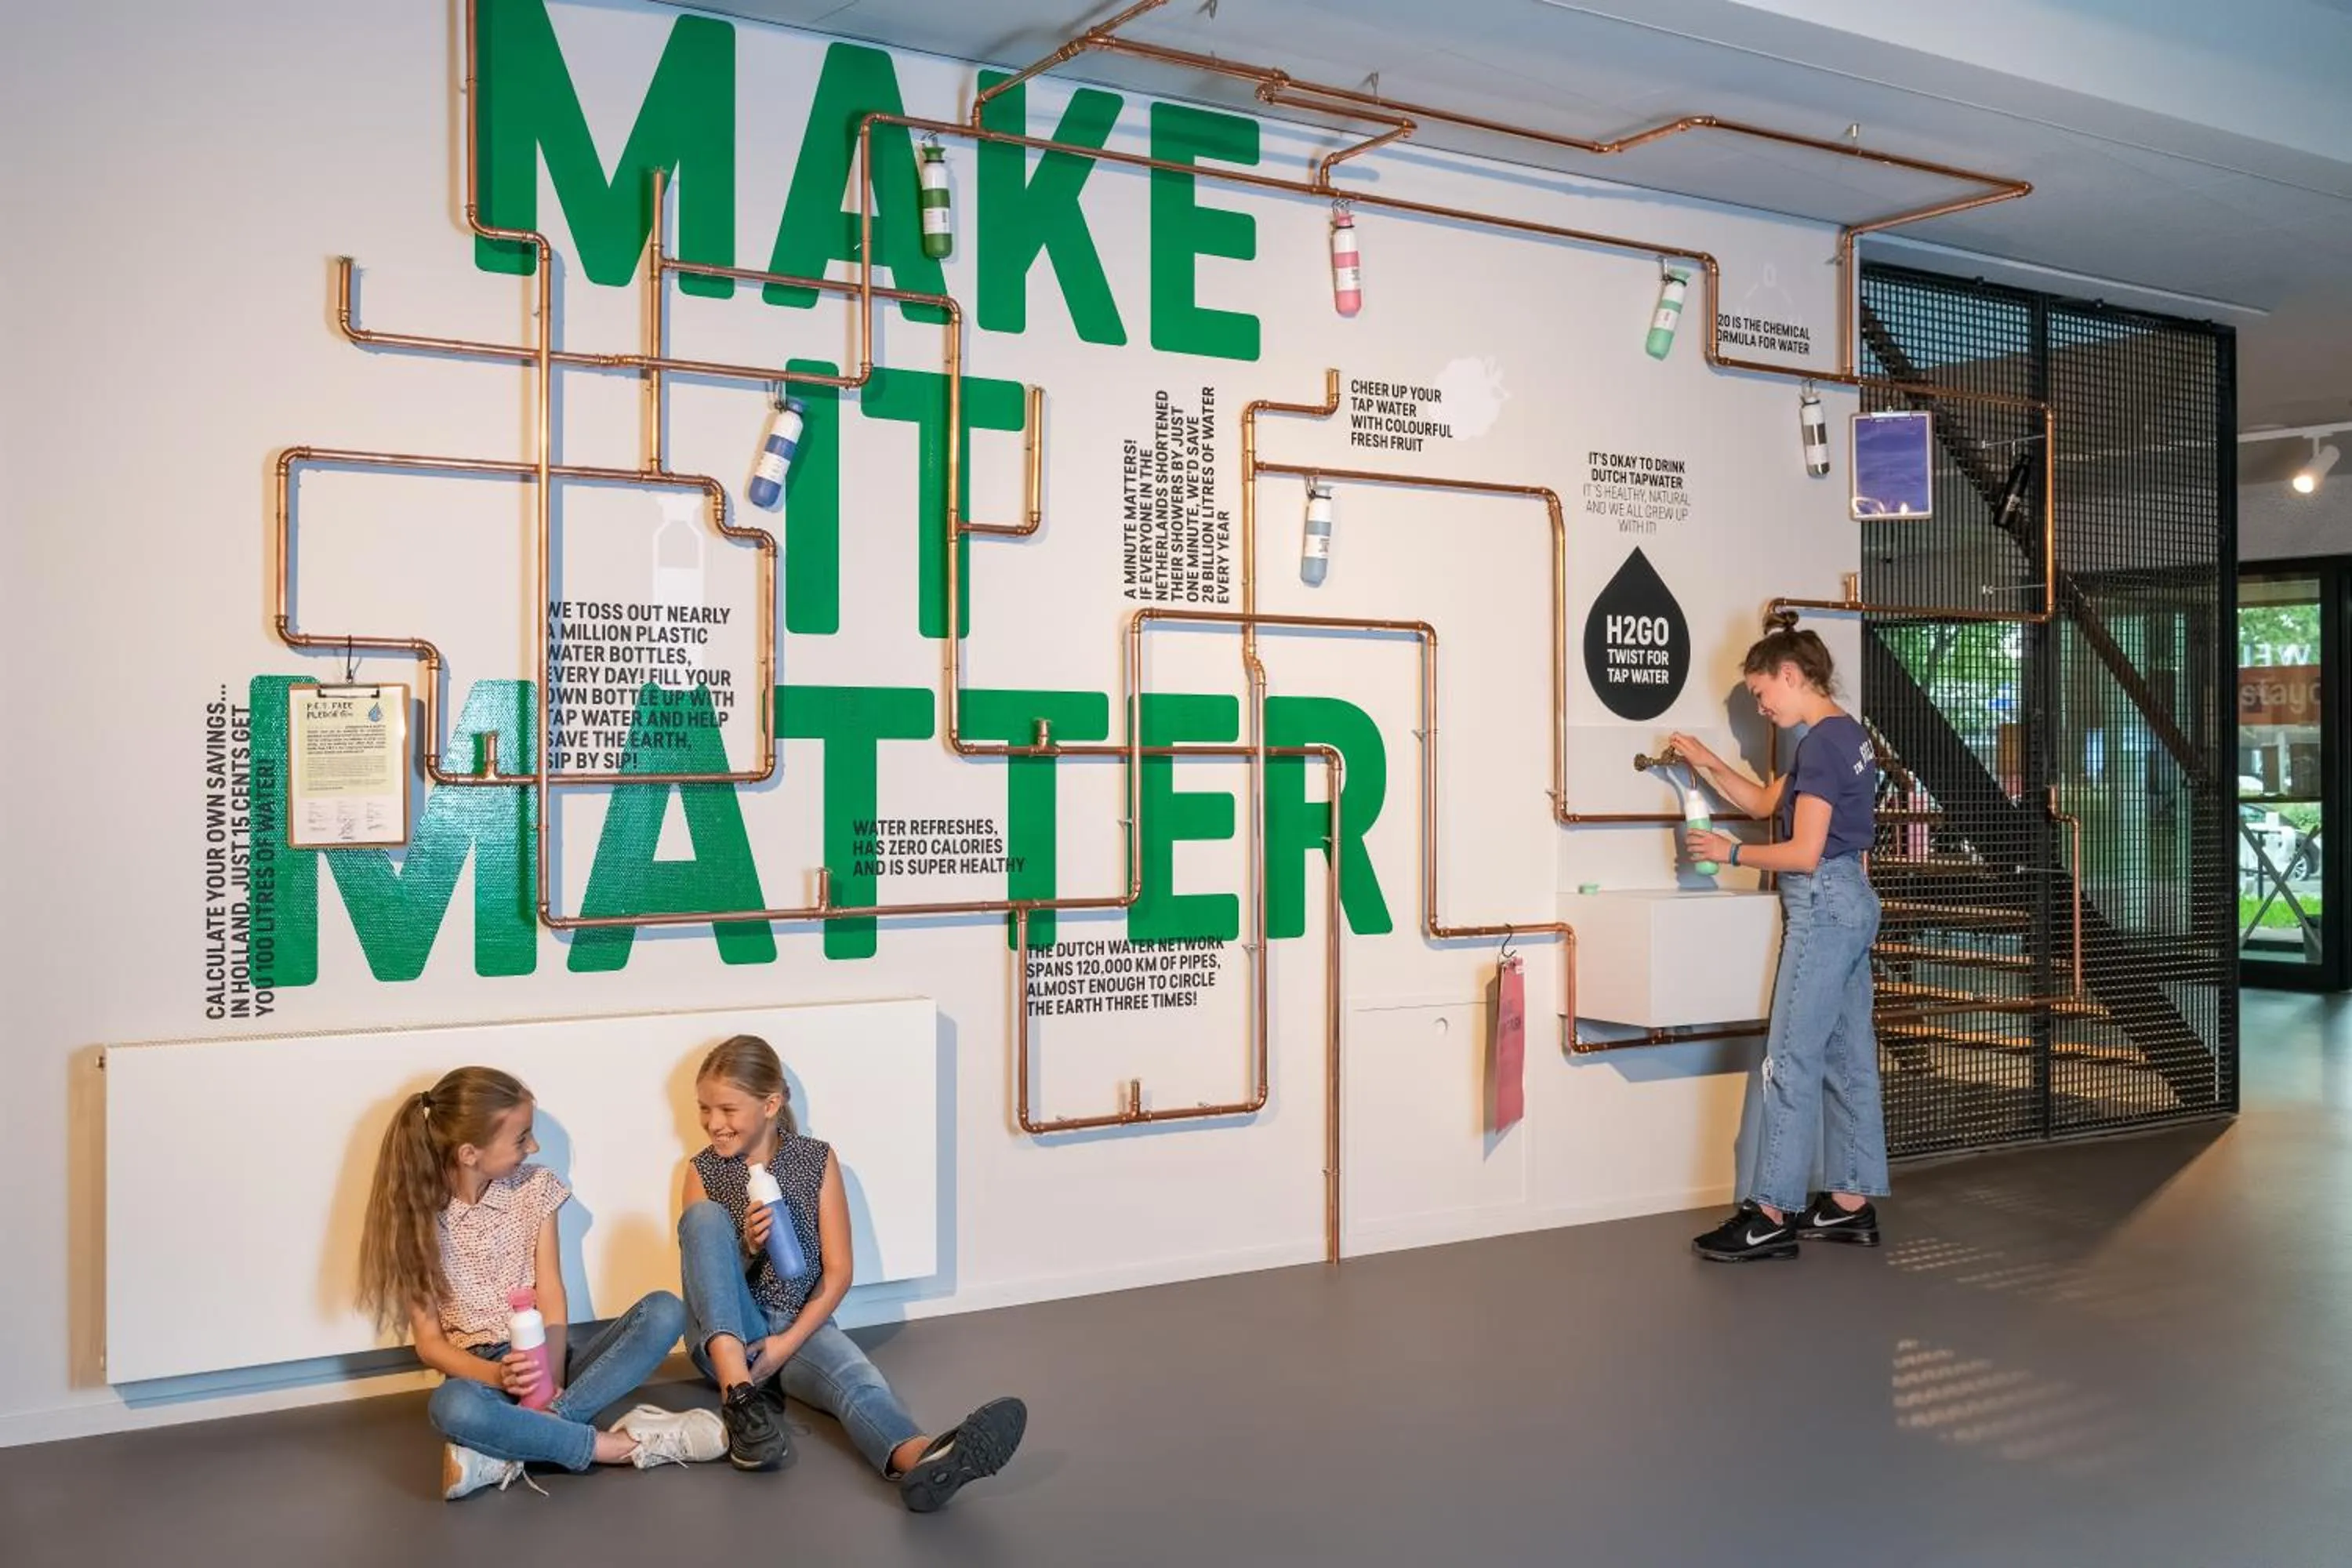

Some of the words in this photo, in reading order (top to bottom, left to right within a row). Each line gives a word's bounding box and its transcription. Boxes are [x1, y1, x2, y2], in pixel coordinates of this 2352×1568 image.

[474, 0, 1261, 362] MAKE
[1733, 316, 1741, 328] IS
[1744, 318, 1762, 332] THE
[1763, 321, 1810, 340] CHEMICAL
[1718, 329, 1756, 347] ORMULA
[1759, 336, 1776, 350] FOR
[1778, 339, 1810, 355] WATER
[1351, 379, 1389, 397] CHEER
[1392, 383, 1407, 398] UP
[1410, 386, 1442, 403] YOUR
[1202, 387, 1214, 439] WATER
[1351, 397, 1374, 412] TAP
[1376, 400, 1417, 417] WATER
[1155, 390, 1168, 483] SHORTENED
[1171, 406, 1183, 447] JUST
[1186, 416, 1199, 456] SAVE
[1351, 414, 1382, 430] WITH
[1385, 418, 1453, 438] COLOURFUL
[1202, 444, 1214, 463] OF
[1351, 432, 1388, 448] FRESH
[1390, 436, 1424, 452] FRUIT
[1139, 448, 1152, 478] THE
[1171, 450, 1183, 470] BY
[1588, 452, 1607, 466] IT'S
[1610, 454, 1637, 469] OKAY
[1639, 457, 1653, 470] TO
[1655, 459, 1685, 474] DRINK
[1123, 439, 1136, 519] MATTERS!
[1139, 482, 1152, 498] IN
[1186, 459, 1199, 499] WE'D
[1592, 468, 1627, 484] DUTCH
[1629, 472, 1683, 489] TAPWATER
[783, 357, 1025, 640] IT
[1202, 467, 1214, 517] LITRES
[1650, 490, 1691, 506] NATURAL
[1171, 474, 1183, 553] SHOWERS
[1586, 499, 1606, 515] AND
[1609, 502, 1624, 517] WE
[1627, 504, 1643, 518] ALL
[1646, 504, 1673, 519] GREW
[1675, 508, 1688, 521] UP
[1186, 504, 1200, 568] MINUTE,
[1217, 511, 1229, 550] YEAR
[1617, 519, 1644, 533] WITH
[1123, 524, 1136, 583] MINUTE
[1139, 502, 1152, 583] EVERYONE
[1155, 488, 1168, 601] NETHERLANDS
[1202, 521, 1214, 581] BILLION
[1171, 557, 1183, 601] THEIR
[1186, 572, 1199, 602] ONE
[1217, 555, 1229, 604] EVERY
[1123, 589, 1136, 599] A
[1139, 586, 1152, 600] IF
[1202, 585, 1214, 602] 28
[549, 602, 572, 619] WE
[576, 602, 623, 619] TOSS
[628, 604, 662, 622] OUT
[668, 606, 730, 624] NEARLY
[561, 623, 631, 641] MILLION
[637, 626, 708, 644] PLASTIC
[1606, 615, 1668, 646] H2GO
[549, 644, 604, 662] WATER
[610, 646, 691, 666] BOTTLES,
[1606, 648, 1645, 665] TWIST
[1647, 650, 1668, 665] FOR
[605, 668, 644, 684] DAY!
[650, 668, 681, 685] FILL
[686, 669, 731, 687] YOUR
[1606, 667, 1629, 683] TAP
[1631, 669, 1669, 684] WATER
[593, 688, 659, 706] BOTTLE
[662, 689, 684, 706] UP
[688, 690, 734, 707] WITH
[230, 704, 250, 741] GET
[582, 710, 642, 727] WATER
[647, 710, 683, 728] AND
[688, 711, 728, 728] HELP
[593, 731, 626, 747] THE
[576, 752, 599, 769] BY
[604, 752, 637, 769] SIP!
[230, 747, 250, 811] CENTS
[206, 794, 226, 843] OWN
[230, 817, 250, 836] 15
[853, 820, 906, 836] WATER
[911, 819, 998, 837] REFRESHES,
[249, 674, 1393, 988] MATTER
[255, 837, 274, 861] OF
[853, 840, 885, 855] HAS
[889, 840, 927, 855] ZERO
[931, 838, 1003, 855] CALORIES
[206, 848, 226, 902] YOUR
[230, 842, 250, 891] JUST
[853, 859, 886, 876] AND
[890, 859, 904, 876] IS
[908, 858, 956, 874] SUPER
[960, 857, 1026, 873] HEALTHY
[255, 867, 274, 931] LITRES
[255, 937, 274, 972] 100
[1027, 942, 1053, 959] THE
[1057, 941, 1104, 957] DUTCH
[1109, 938, 1154, 955] WATER
[1158, 935, 1224, 953] NETWORK
[206, 907, 226, 1019] CALCULATE
[1027, 960, 1073, 978] SPANS
[1136, 956, 1156, 972] KM
[1160, 955, 1176, 971] OF
[1180, 953, 1221, 970] PIPES,
[1027, 979, 1085, 996] ALMOST
[1089, 976, 1145, 993] ENOUGH
[1149, 975, 1166, 990] TO
[1169, 972, 1215, 989] CIRCLE
[230, 999, 250, 1018] IN
[255, 976, 274, 1017] YOU
[1027, 1000, 1053, 1017] THE
[1057, 997, 1102, 1015] EARTH
[1105, 994, 1149, 1011] THREE
[1152, 991, 1197, 1008] TIMES!
